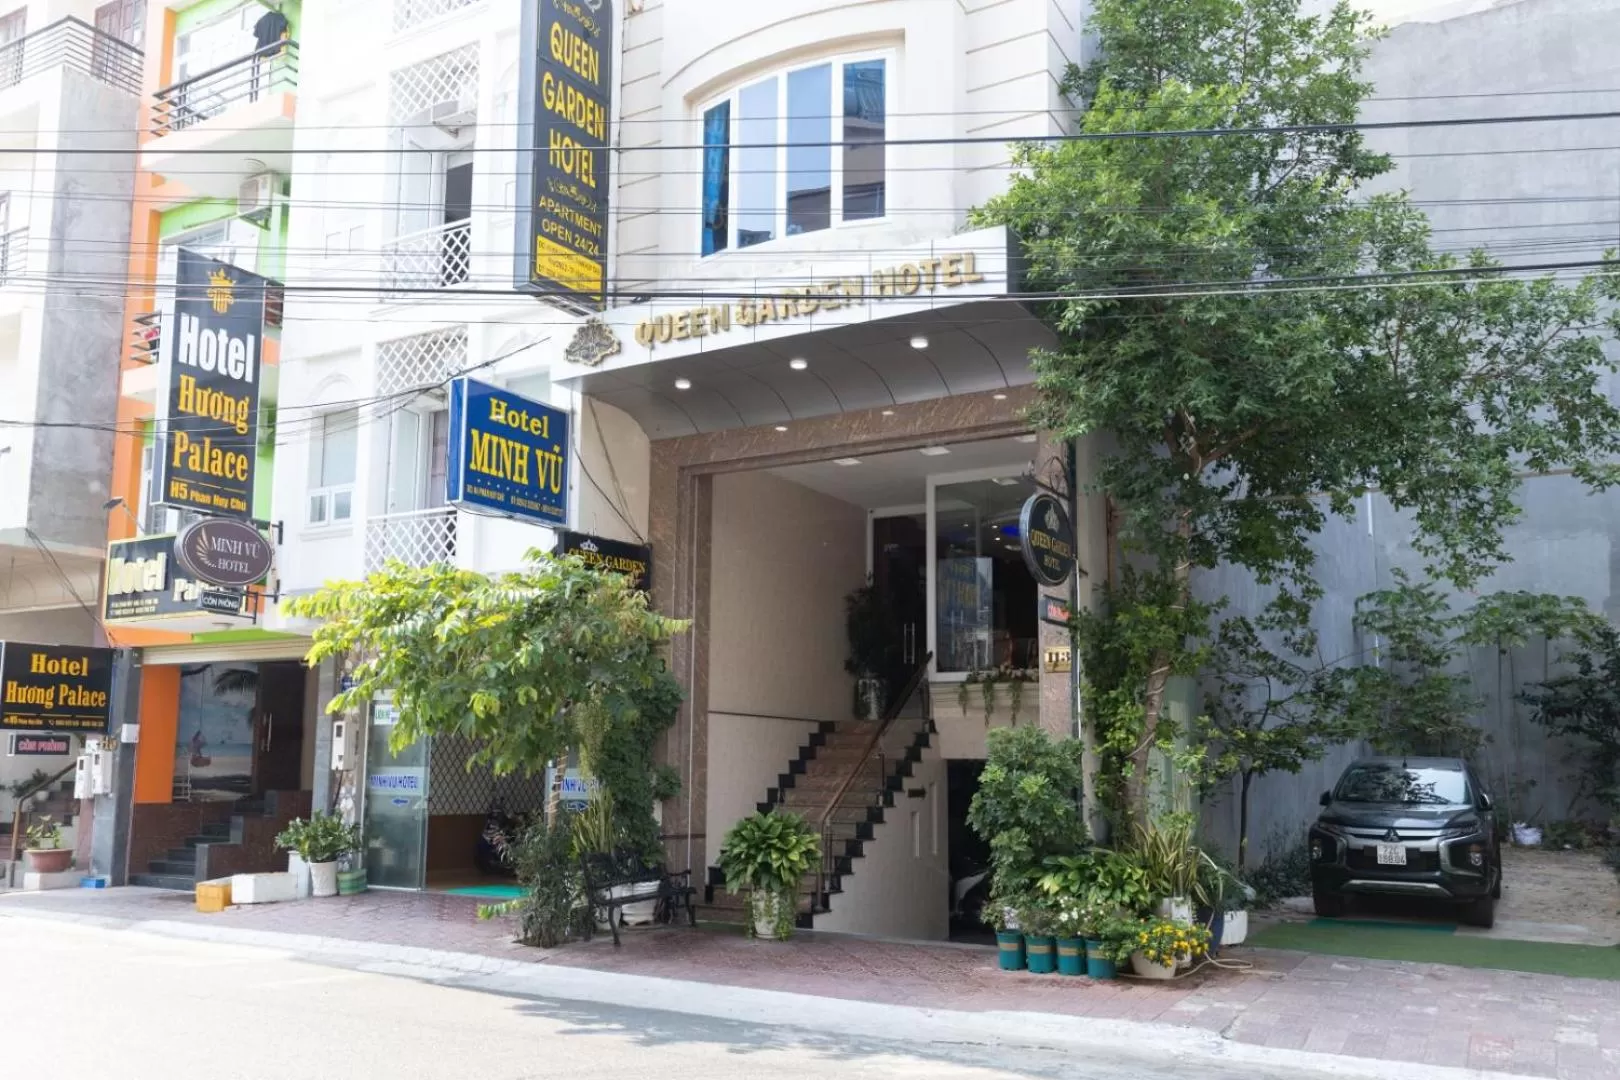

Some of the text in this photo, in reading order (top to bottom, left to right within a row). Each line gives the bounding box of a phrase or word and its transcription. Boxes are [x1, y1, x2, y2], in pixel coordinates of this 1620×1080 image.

[551, 22, 599, 86] QUEEN
[543, 71, 604, 141] GARDEN
[549, 128, 596, 188] HOTEL
[539, 195, 602, 237] APARTMENT
[541, 219, 599, 256] OPEN 24/24
[635, 252, 986, 349] QUEEN GARDEN HOTEL
[179, 312, 255, 384] Hotel
[178, 374, 249, 434] Hương
[489, 397, 549, 438] Hotel
[172, 430, 248, 481] Palace
[470, 428, 530, 485] MINH
[211, 535, 242, 556] MINH
[1031, 528, 1051, 550] QUEEN
[218, 558, 253, 575] HOTEL
[31, 653, 88, 677] Hotel
[5, 680, 106, 709] Hương Palace
